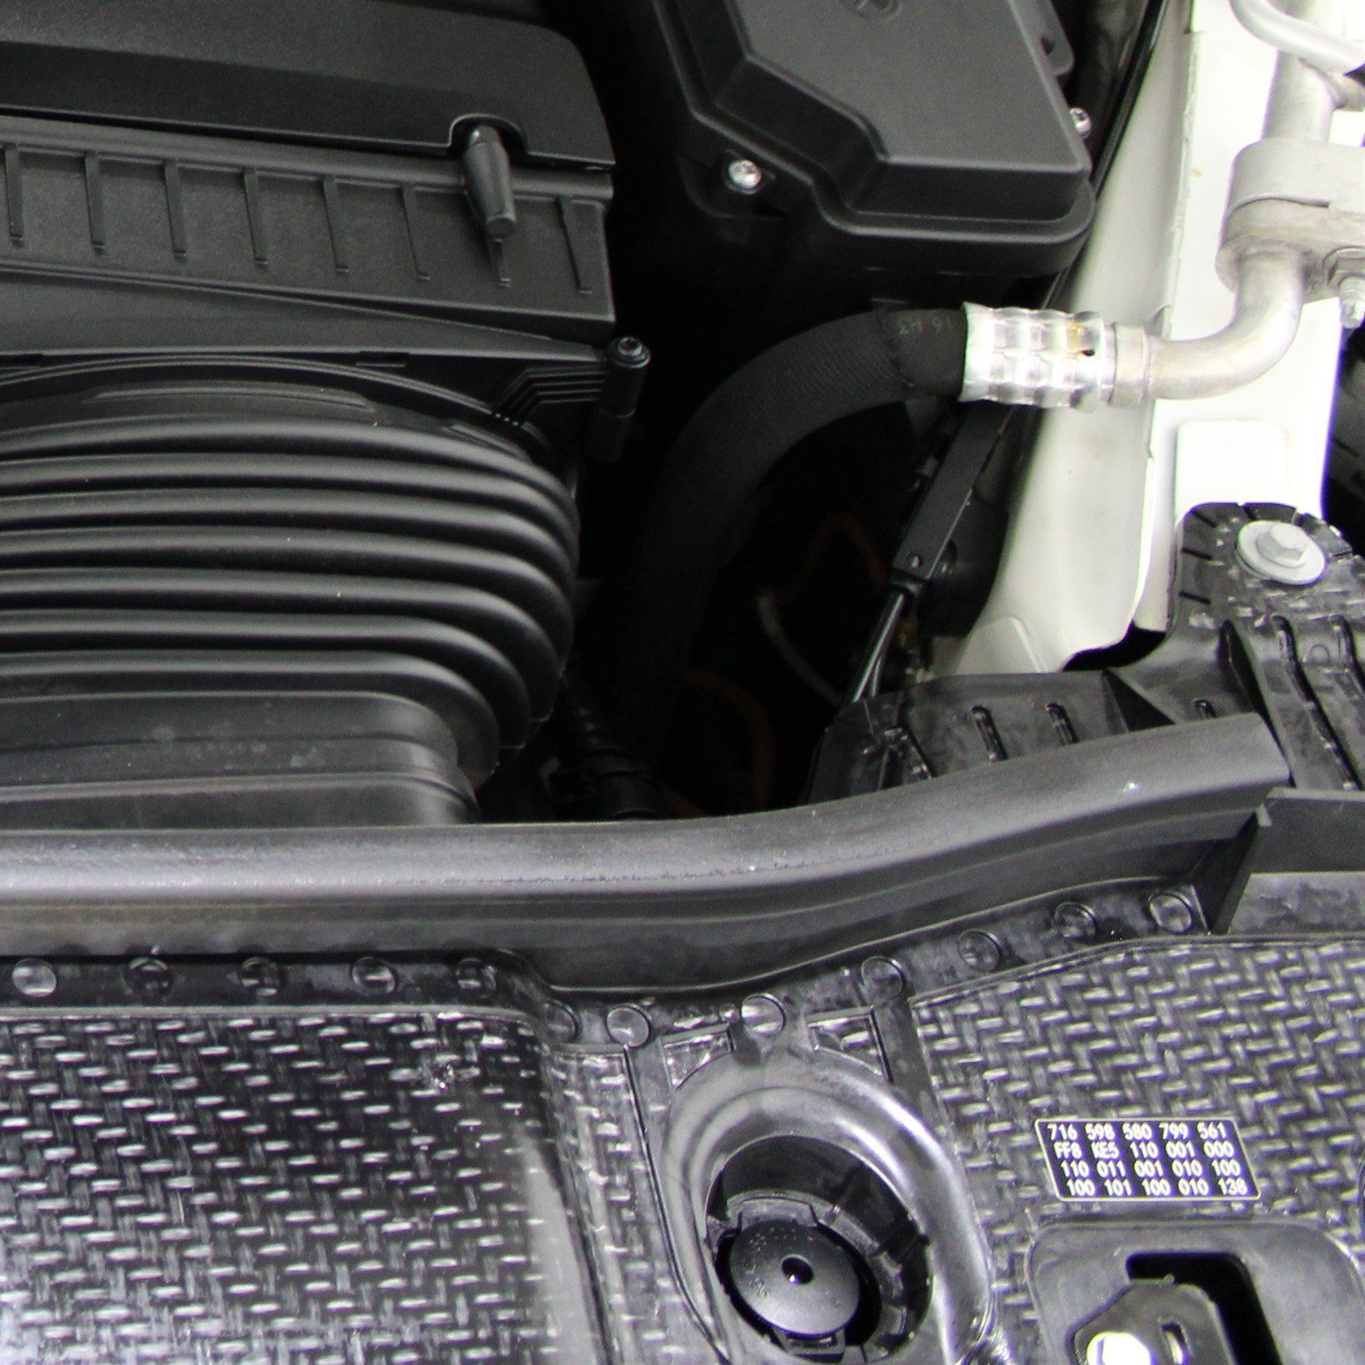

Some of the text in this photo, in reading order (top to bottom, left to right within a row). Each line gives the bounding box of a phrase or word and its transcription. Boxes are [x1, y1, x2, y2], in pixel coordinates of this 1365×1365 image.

[1048, 1124, 1078, 1140] 716
[1085, 1124, 1115, 1140] 598
[1159, 1123, 1189, 1139] 799
[1197, 1122, 1227, 1139] 561
[1091, 1142, 1119, 1158] KE5
[1129, 1142, 1158, 1158] 110
[1166, 1142, 1195, 1158] 001
[1204, 1141, 1233, 1158] 000
[1061, 1160, 1240, 1177] 110 011 001 010 100
[1067, 1179, 1095, 1196] 100
[1105, 1179, 1131, 1196] 101
[1142, 1179, 1171, 1196] 100
[1178, 1178, 1208, 1195] 010
